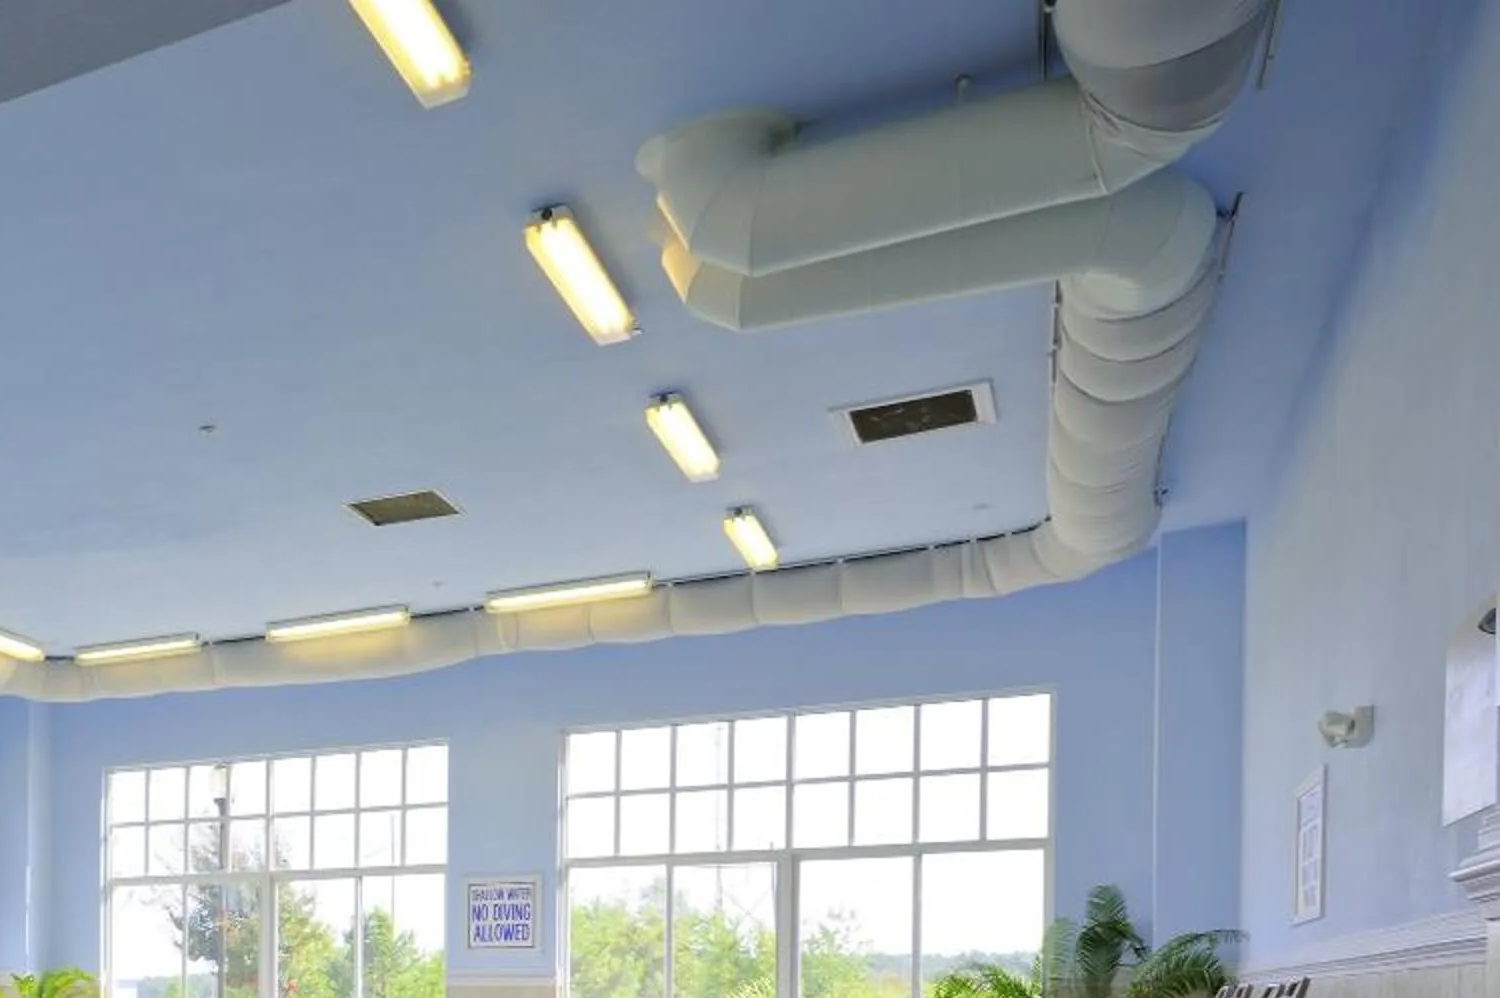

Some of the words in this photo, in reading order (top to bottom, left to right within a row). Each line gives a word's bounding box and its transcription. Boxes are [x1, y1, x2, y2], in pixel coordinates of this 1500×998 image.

[472, 904, 489, 921] NO
[493, 903, 531, 921] DIVING
[473, 923, 531, 942] ALLOWED
